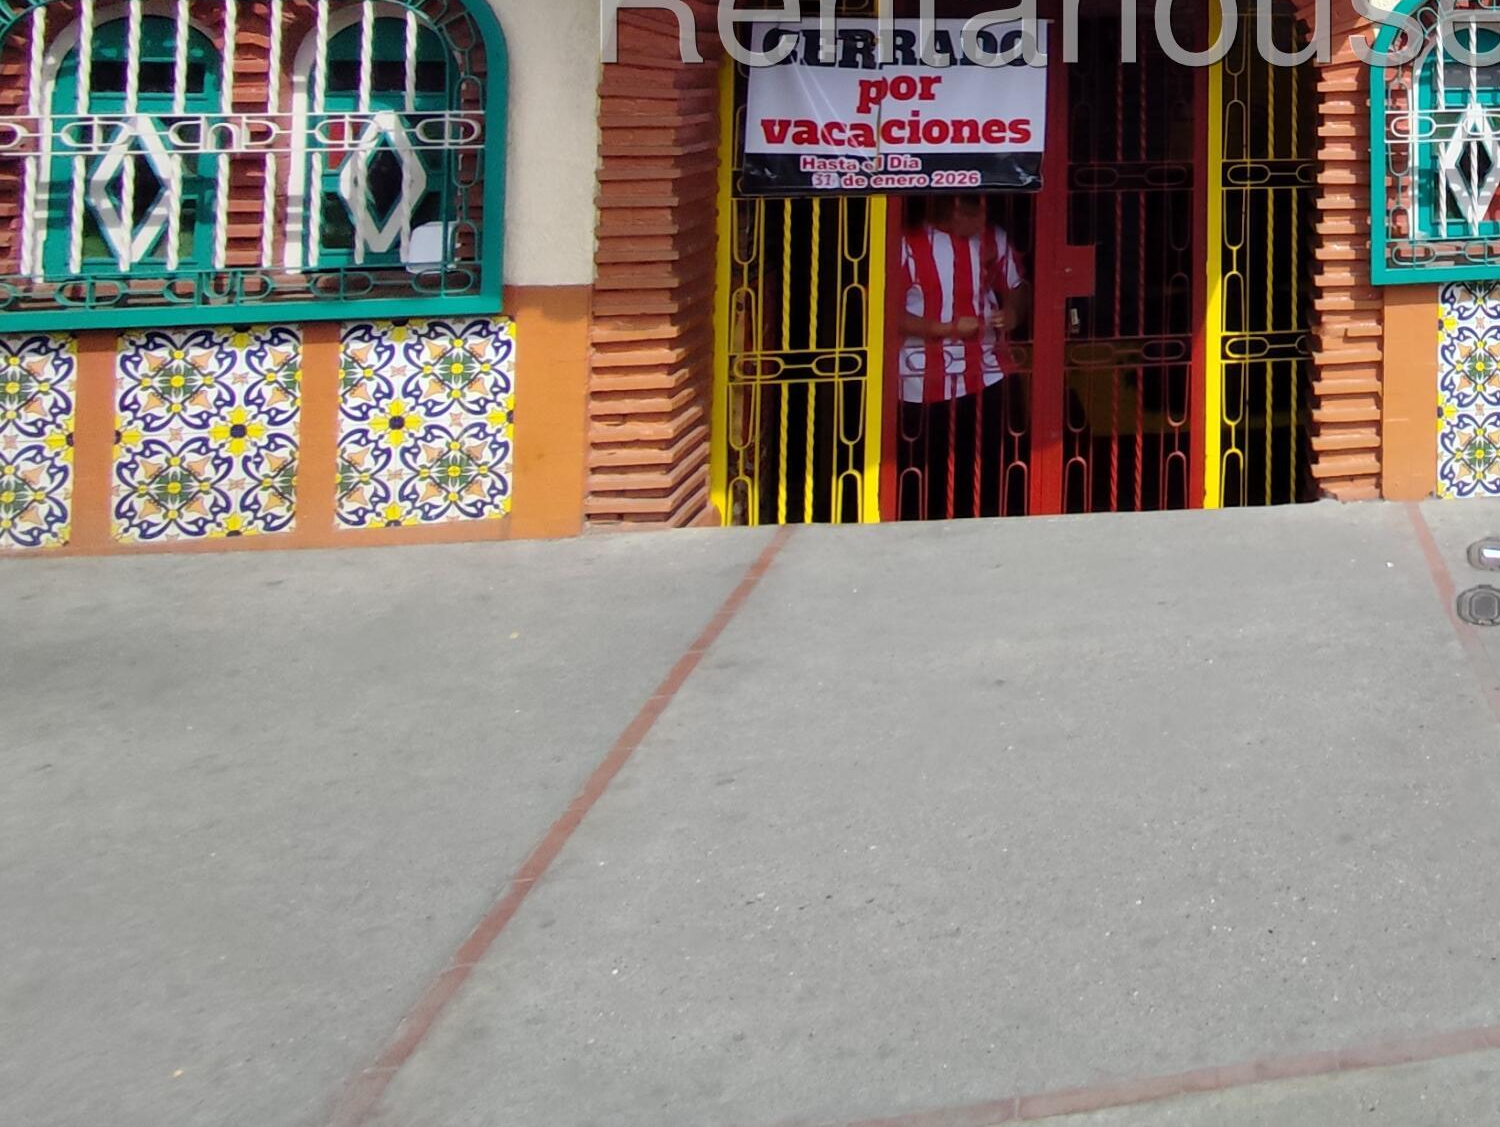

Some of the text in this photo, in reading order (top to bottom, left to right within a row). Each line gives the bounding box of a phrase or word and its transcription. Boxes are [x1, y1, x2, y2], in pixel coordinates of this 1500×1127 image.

[762, 28, 1039, 70] CERRADO
[856, 74, 943, 114] por
[760, 110, 1032, 149] vacaciones
[801, 155, 859, 172] Hasta
[842, 173, 868, 188] de
[870, 173, 929, 188] enero
[931, 170, 982, 187] 2026
